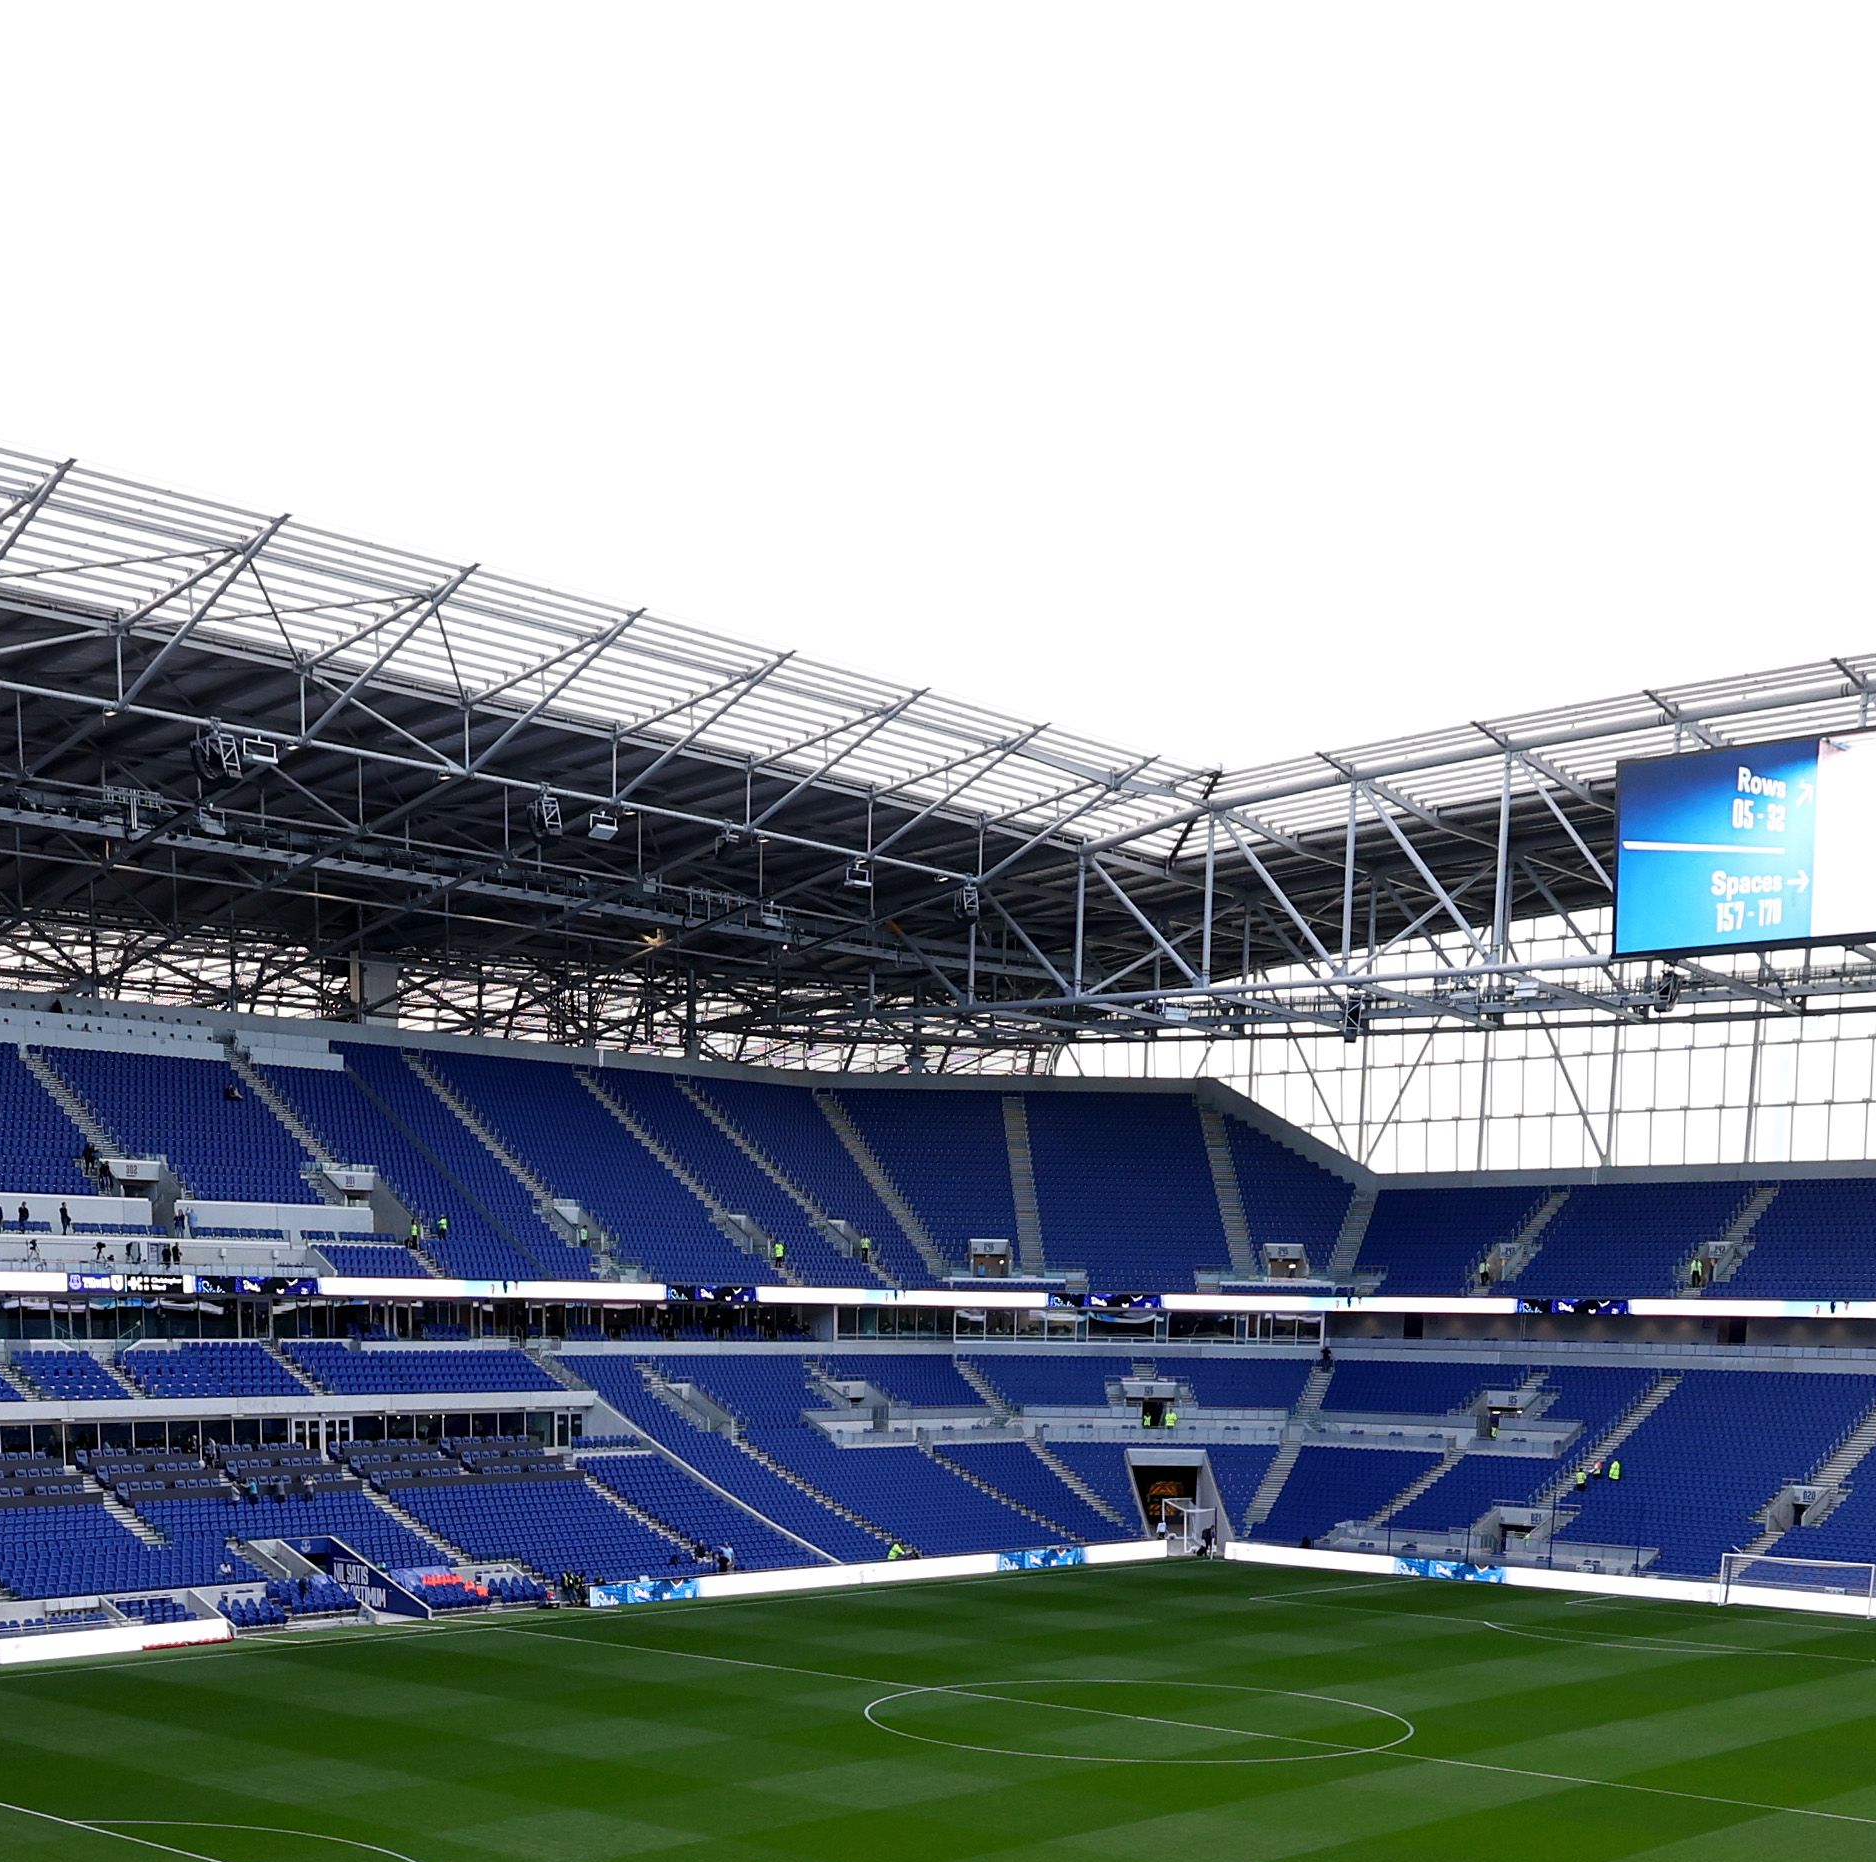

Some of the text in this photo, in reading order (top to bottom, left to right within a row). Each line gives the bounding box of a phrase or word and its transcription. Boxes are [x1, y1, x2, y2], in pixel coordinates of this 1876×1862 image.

[1737, 766, 1787, 798] Rows
[1732, 798, 1755, 829] 05
[1766, 804, 1786, 833] 32
[1711, 870, 1782, 900] Spaces
[1716, 901, 1745, 933] 157
[1758, 898, 1782, 928] 170
[126, 1164, 138, 1175] 302
[346, 1564, 369, 1585] SATIS
